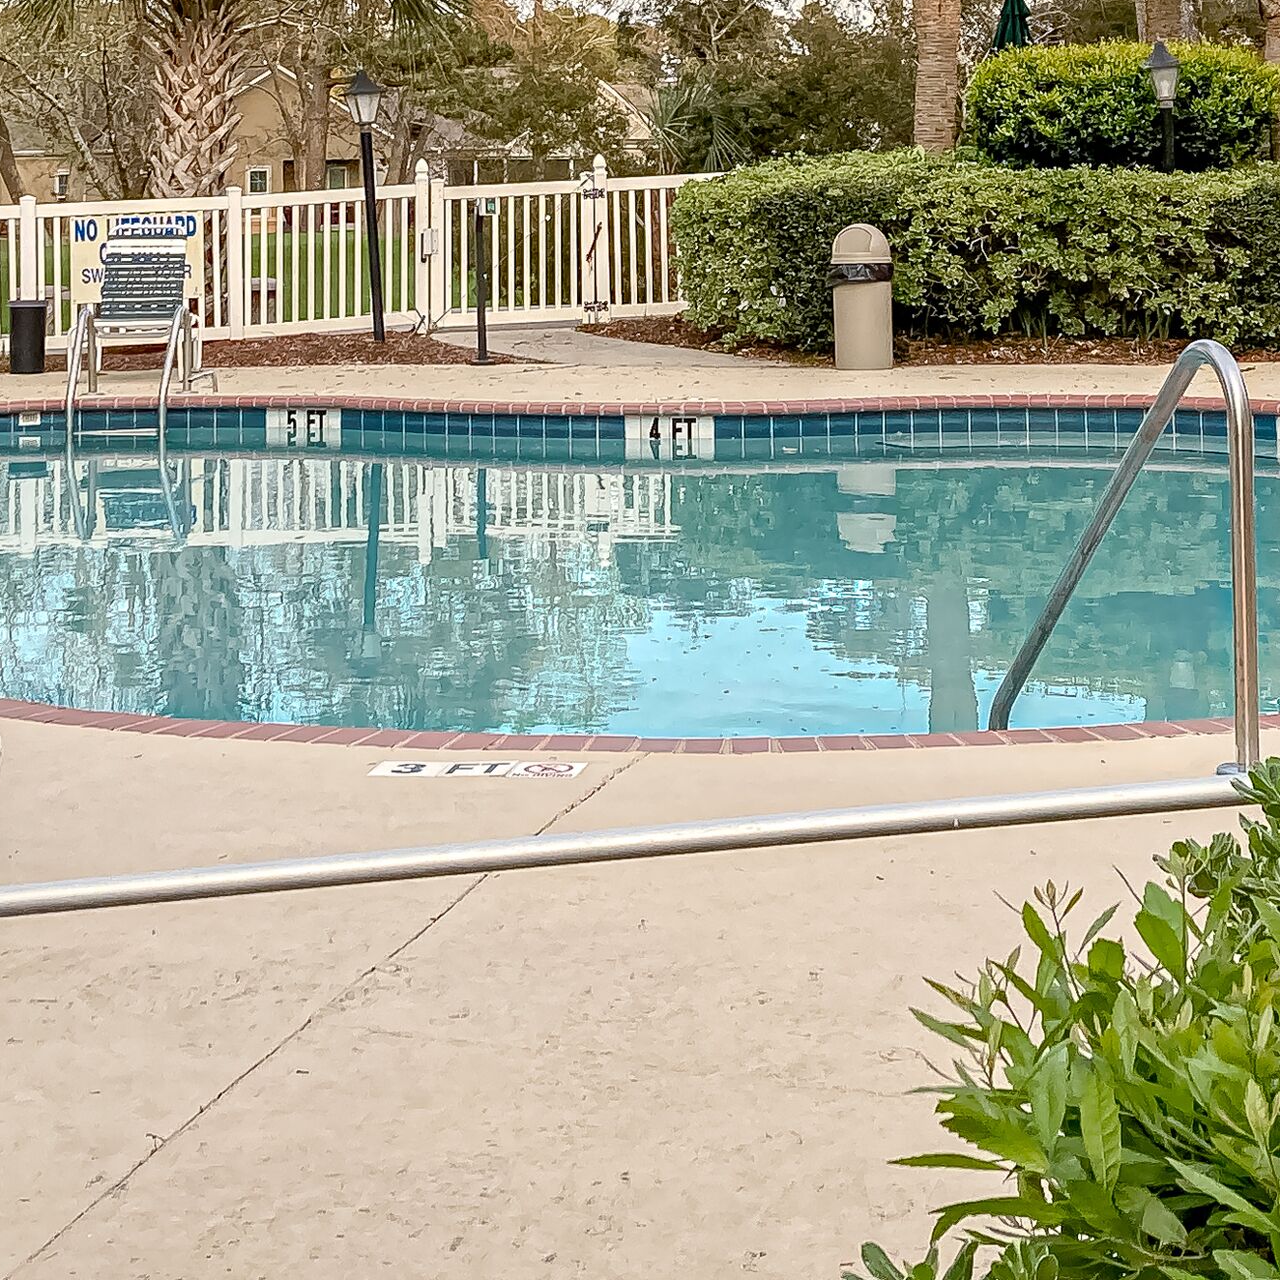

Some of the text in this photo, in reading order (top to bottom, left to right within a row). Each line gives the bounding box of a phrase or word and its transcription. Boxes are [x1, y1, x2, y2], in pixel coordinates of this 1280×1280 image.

[74, 219, 98, 241] NO
[649, 417, 696, 440] 4 FT
[391, 763, 510, 774] 3 FT
